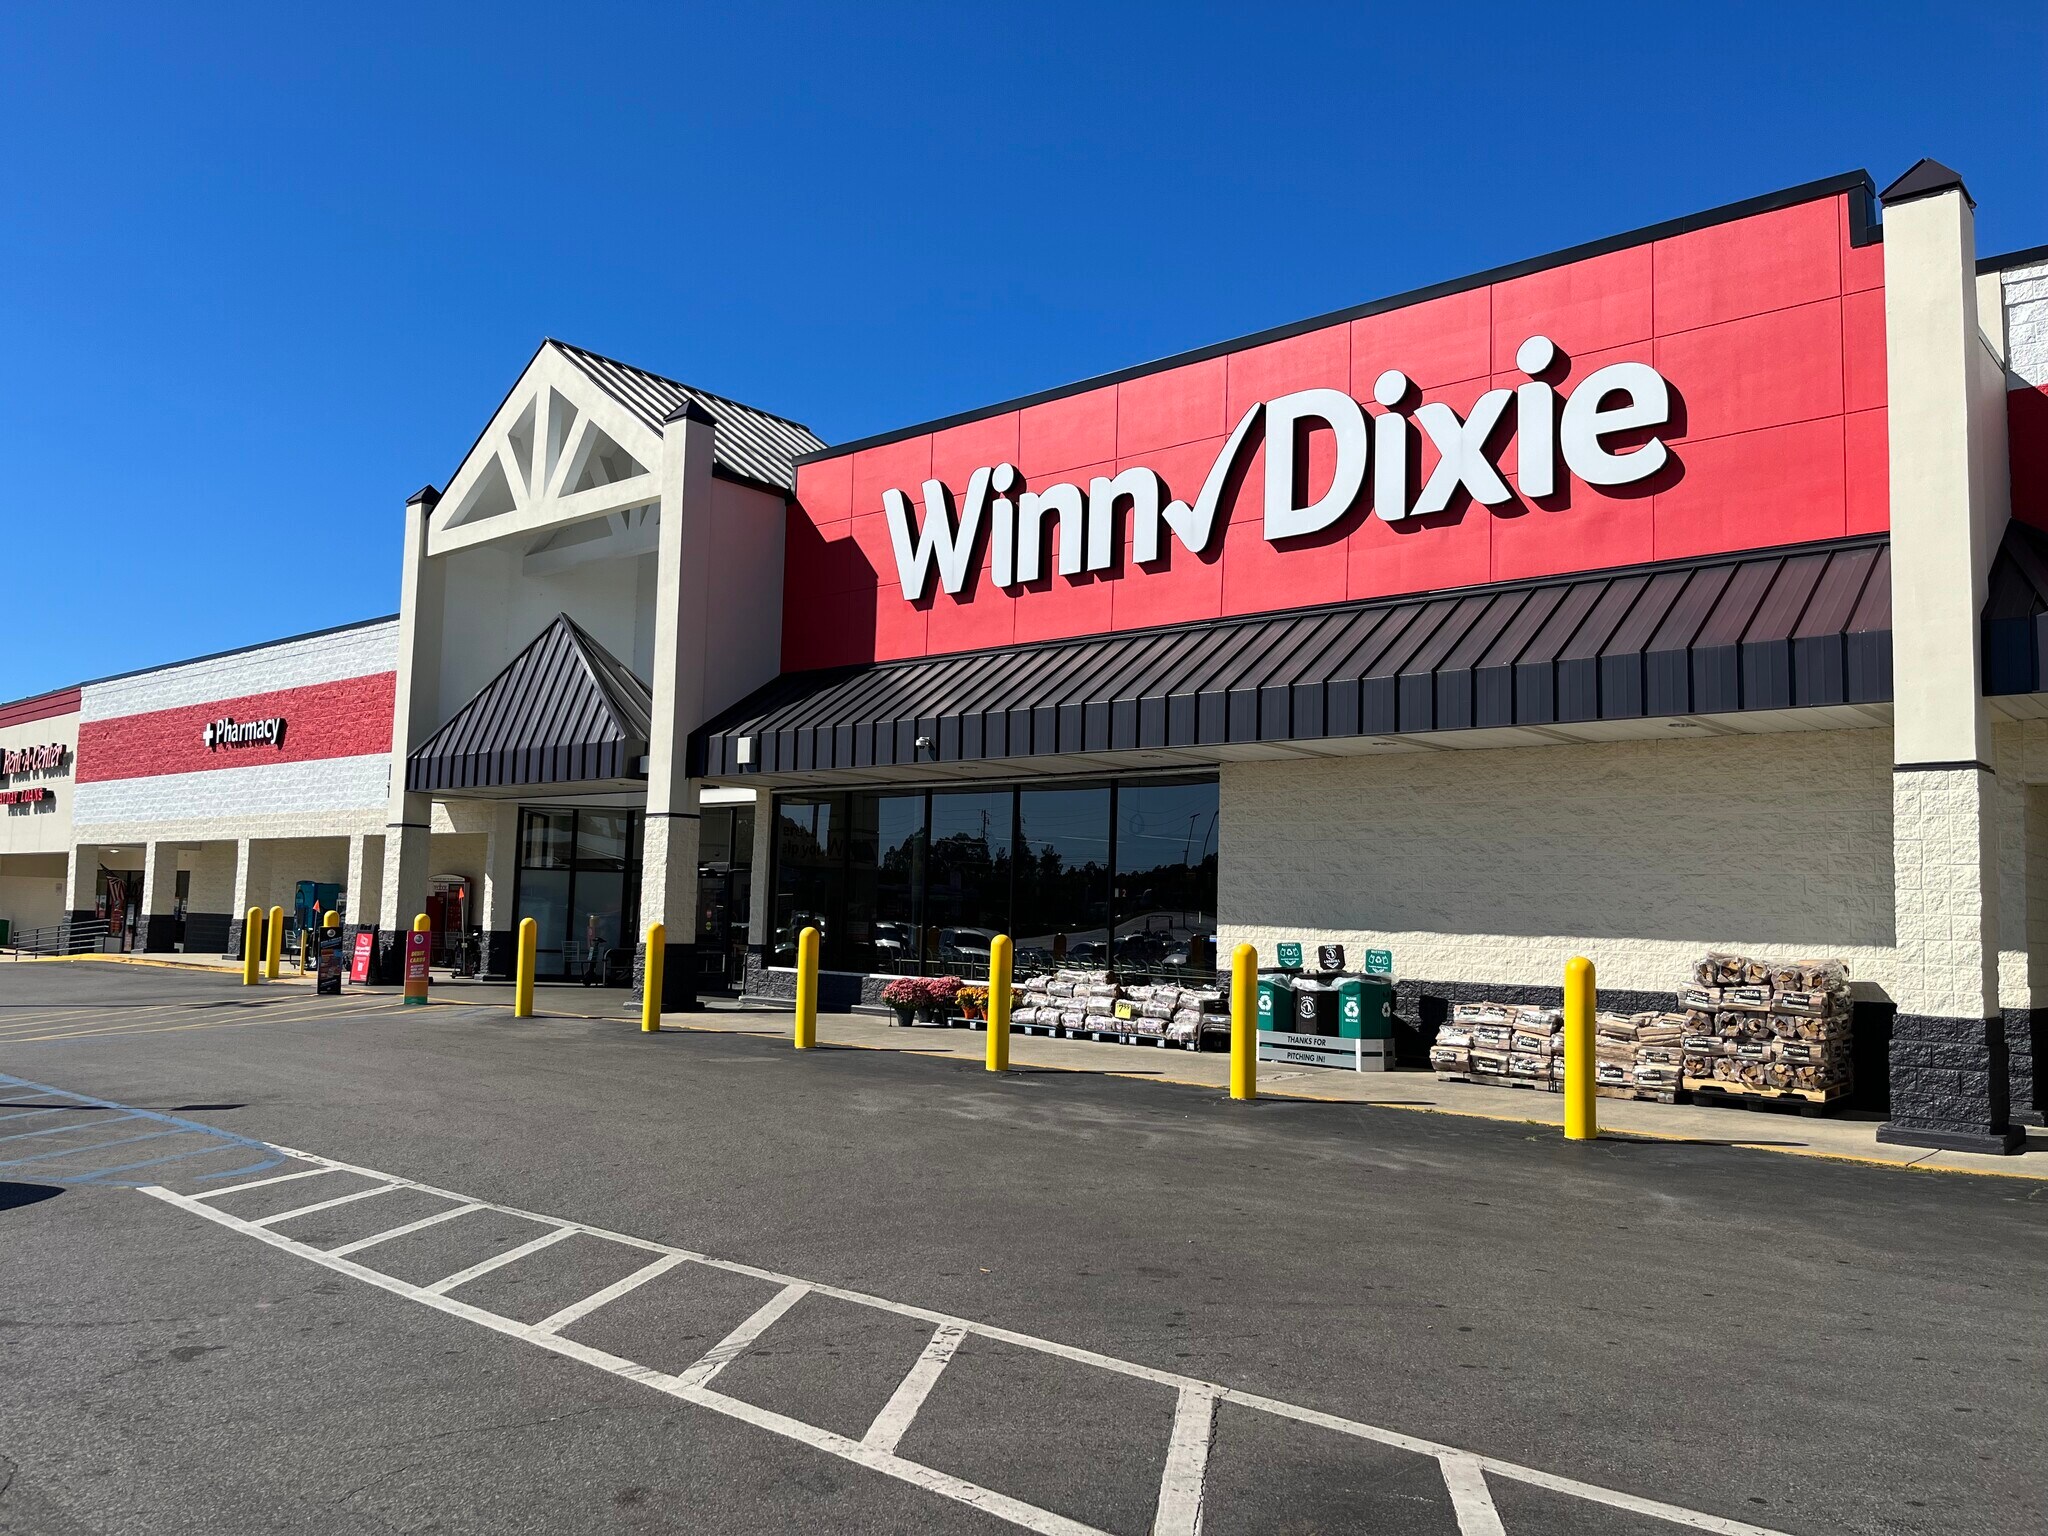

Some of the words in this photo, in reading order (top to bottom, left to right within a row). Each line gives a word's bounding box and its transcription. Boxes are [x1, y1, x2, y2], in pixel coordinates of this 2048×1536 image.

[881, 462, 1159, 601] Winn
[1263, 334, 1670, 541] Dixie
[216, 717, 281, 745] Pharmacy
[20, 787, 44, 803] LOANS
[1287, 1035, 1313, 1045] THANKS
[1313, 1038, 1327, 1047] FOR
[1286, 1051, 1315, 1062] PITCHING
[1316, 1055, 1326, 1063] IN!
